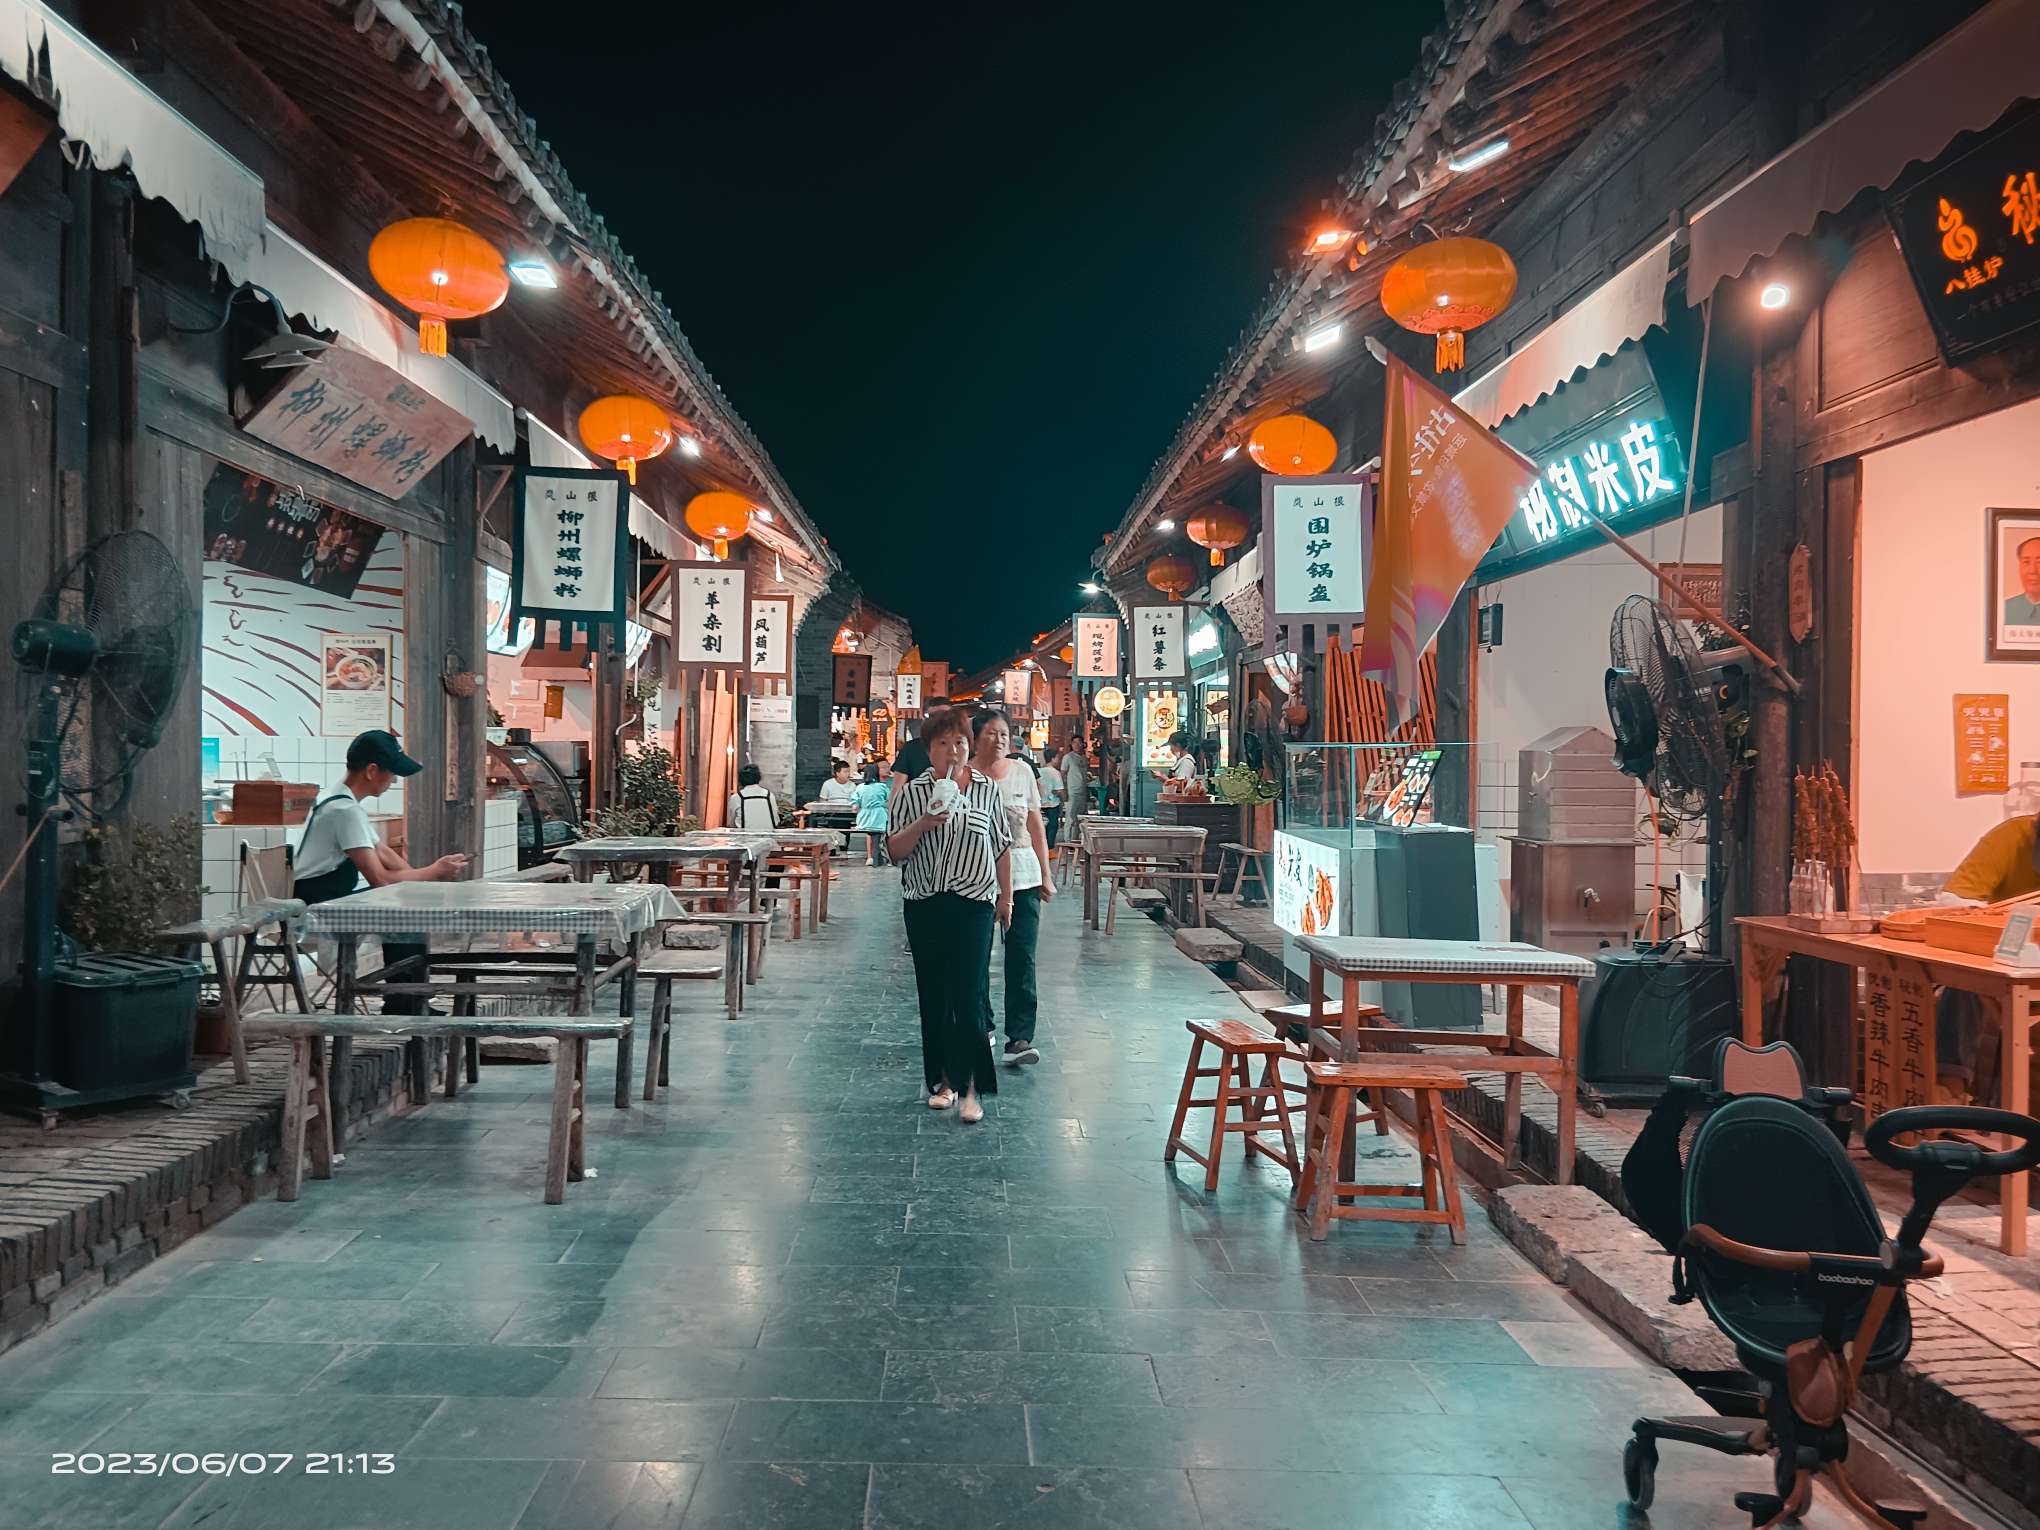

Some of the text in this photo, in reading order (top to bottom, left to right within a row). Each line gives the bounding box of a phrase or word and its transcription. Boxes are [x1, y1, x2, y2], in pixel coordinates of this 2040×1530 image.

[277, 377, 433, 484] 柳州螺蛳粉
[553, 509, 584, 598] 柳州螺蛳粉
[1306, 517, 1333, 603] 围炉锅盔
[702, 591, 723, 653] 羊杂割
[754, 618, 770, 666] 风葫芦
[1152, 624, 1168, 671] 红薯条
